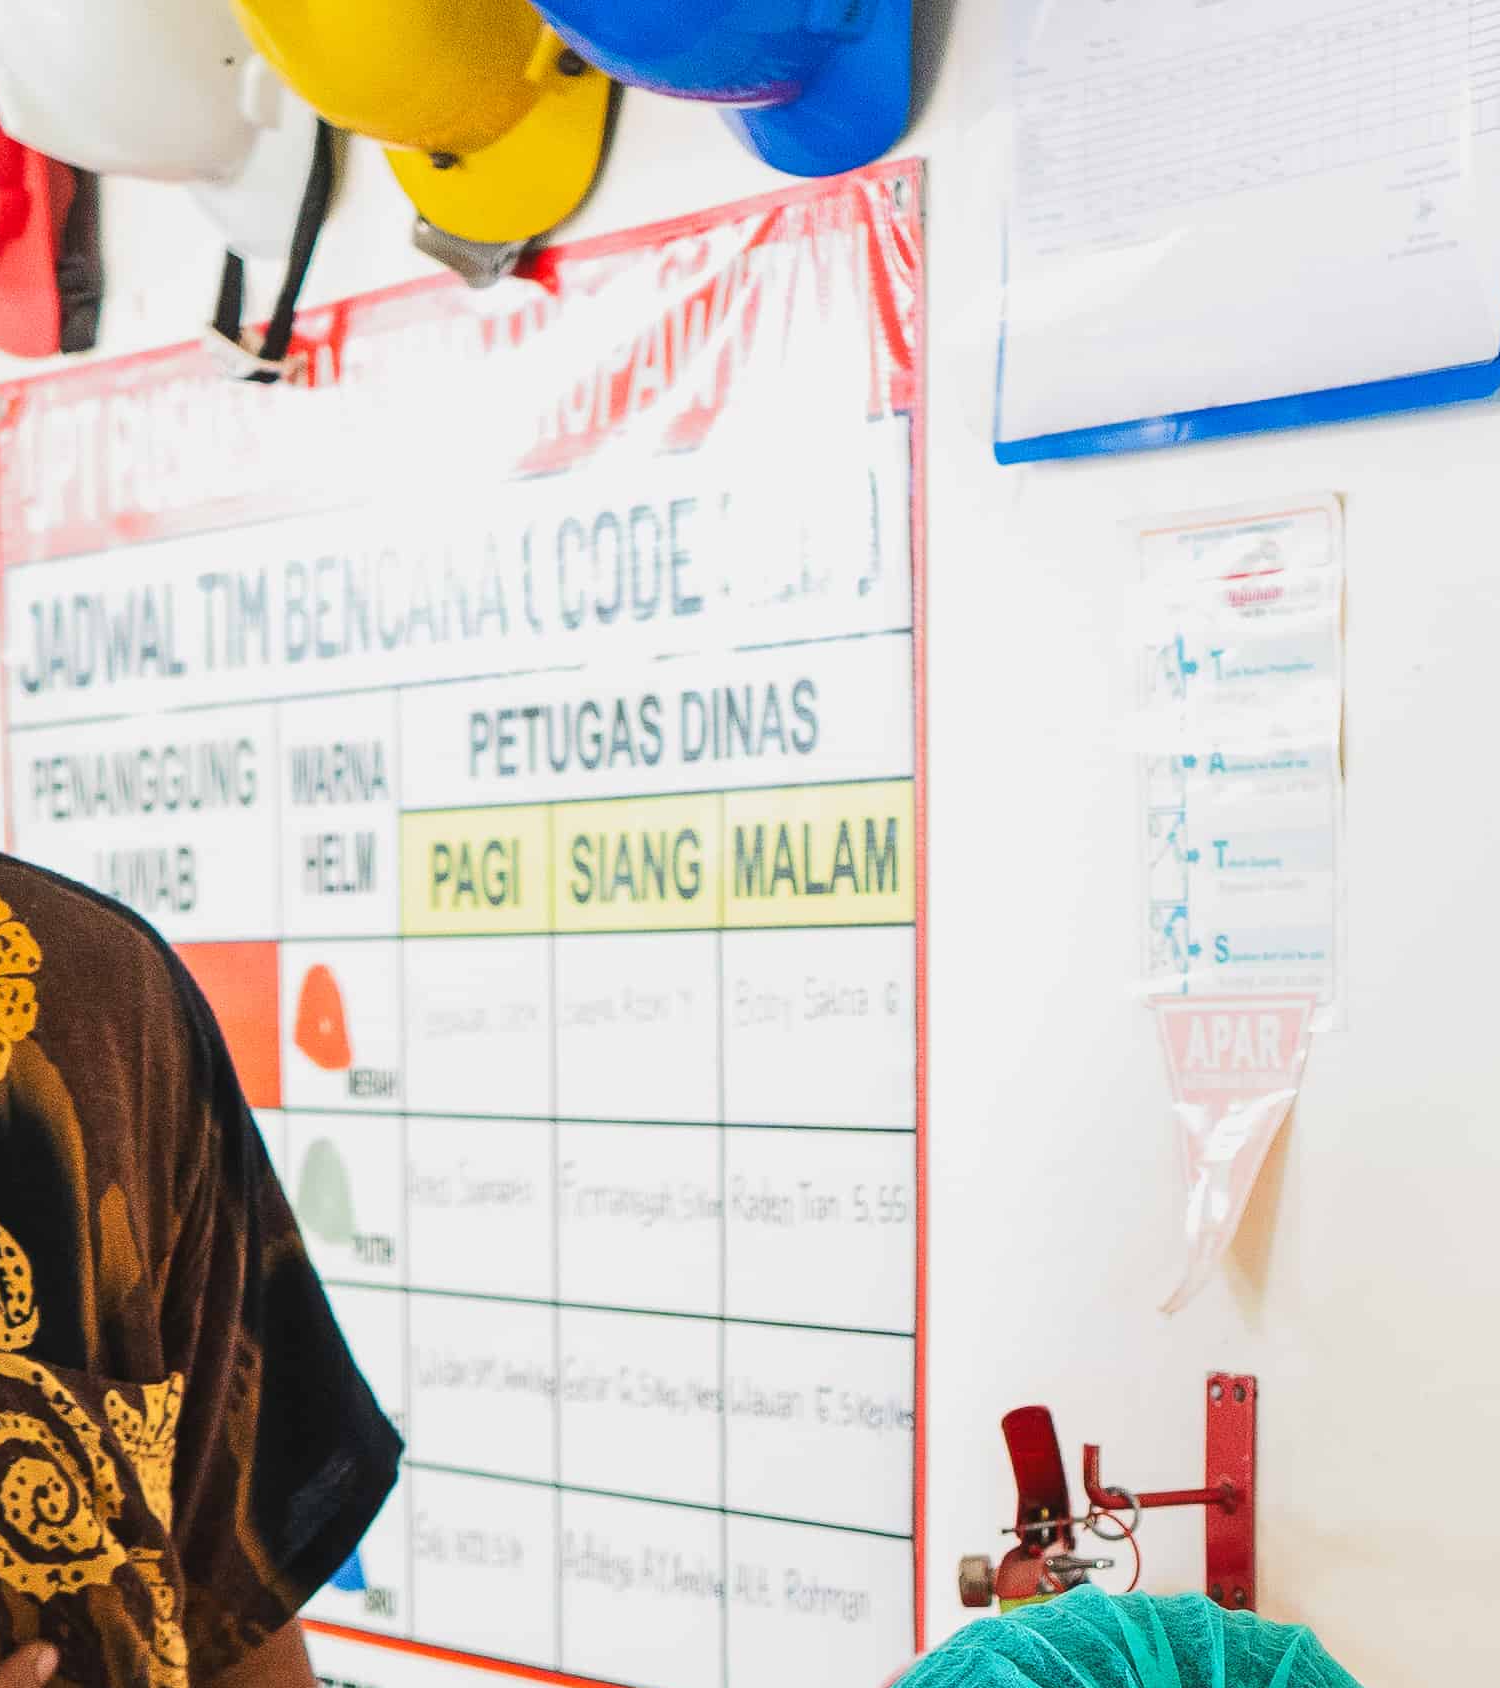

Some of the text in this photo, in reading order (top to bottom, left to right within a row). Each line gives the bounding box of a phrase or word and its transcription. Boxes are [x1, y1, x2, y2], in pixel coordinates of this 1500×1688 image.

[21, 582, 186, 693] JADWAL
[198, 571, 271, 669] TIM
[285, 533, 509, 661] BENCANA
[470, 678, 820, 778] PETUGAS DINAS
[32, 739, 389, 820] PENANGGUNG WARNA
[302, 830, 376, 895] HELM
[430, 817, 899, 910] PAGI SIANG MALAM
[1187, 1014, 1282, 1070] APAR
